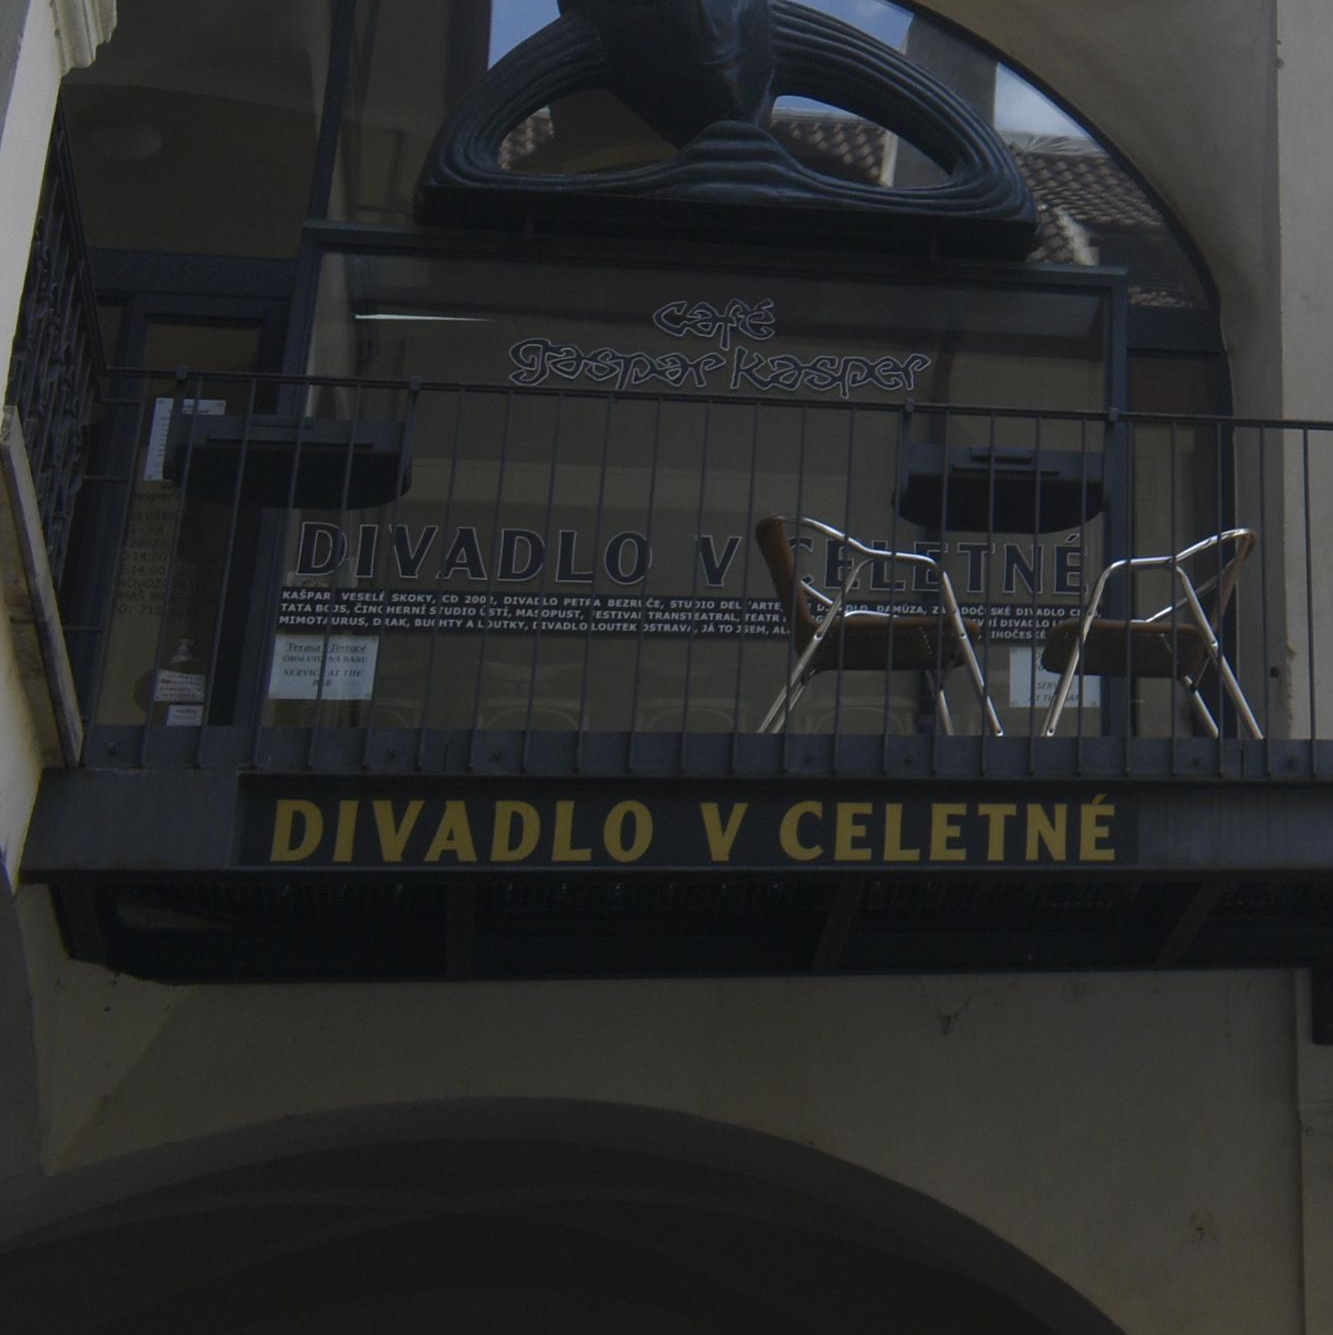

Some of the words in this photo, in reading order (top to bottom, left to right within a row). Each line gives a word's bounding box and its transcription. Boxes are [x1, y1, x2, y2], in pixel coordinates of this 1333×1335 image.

[295, 521, 653, 586] DIVADLO
[697, 534, 743, 587] V
[442, 595, 459, 603] CD
[281, 603, 312, 612] TATA
[465, 619, 474, 628] A
[591, 622, 637, 632] LOUTEK
[269, 798, 655, 864] DIVADLO
[699, 801, 750, 863] V
[778, 792, 1117, 863] CELETNÉ
